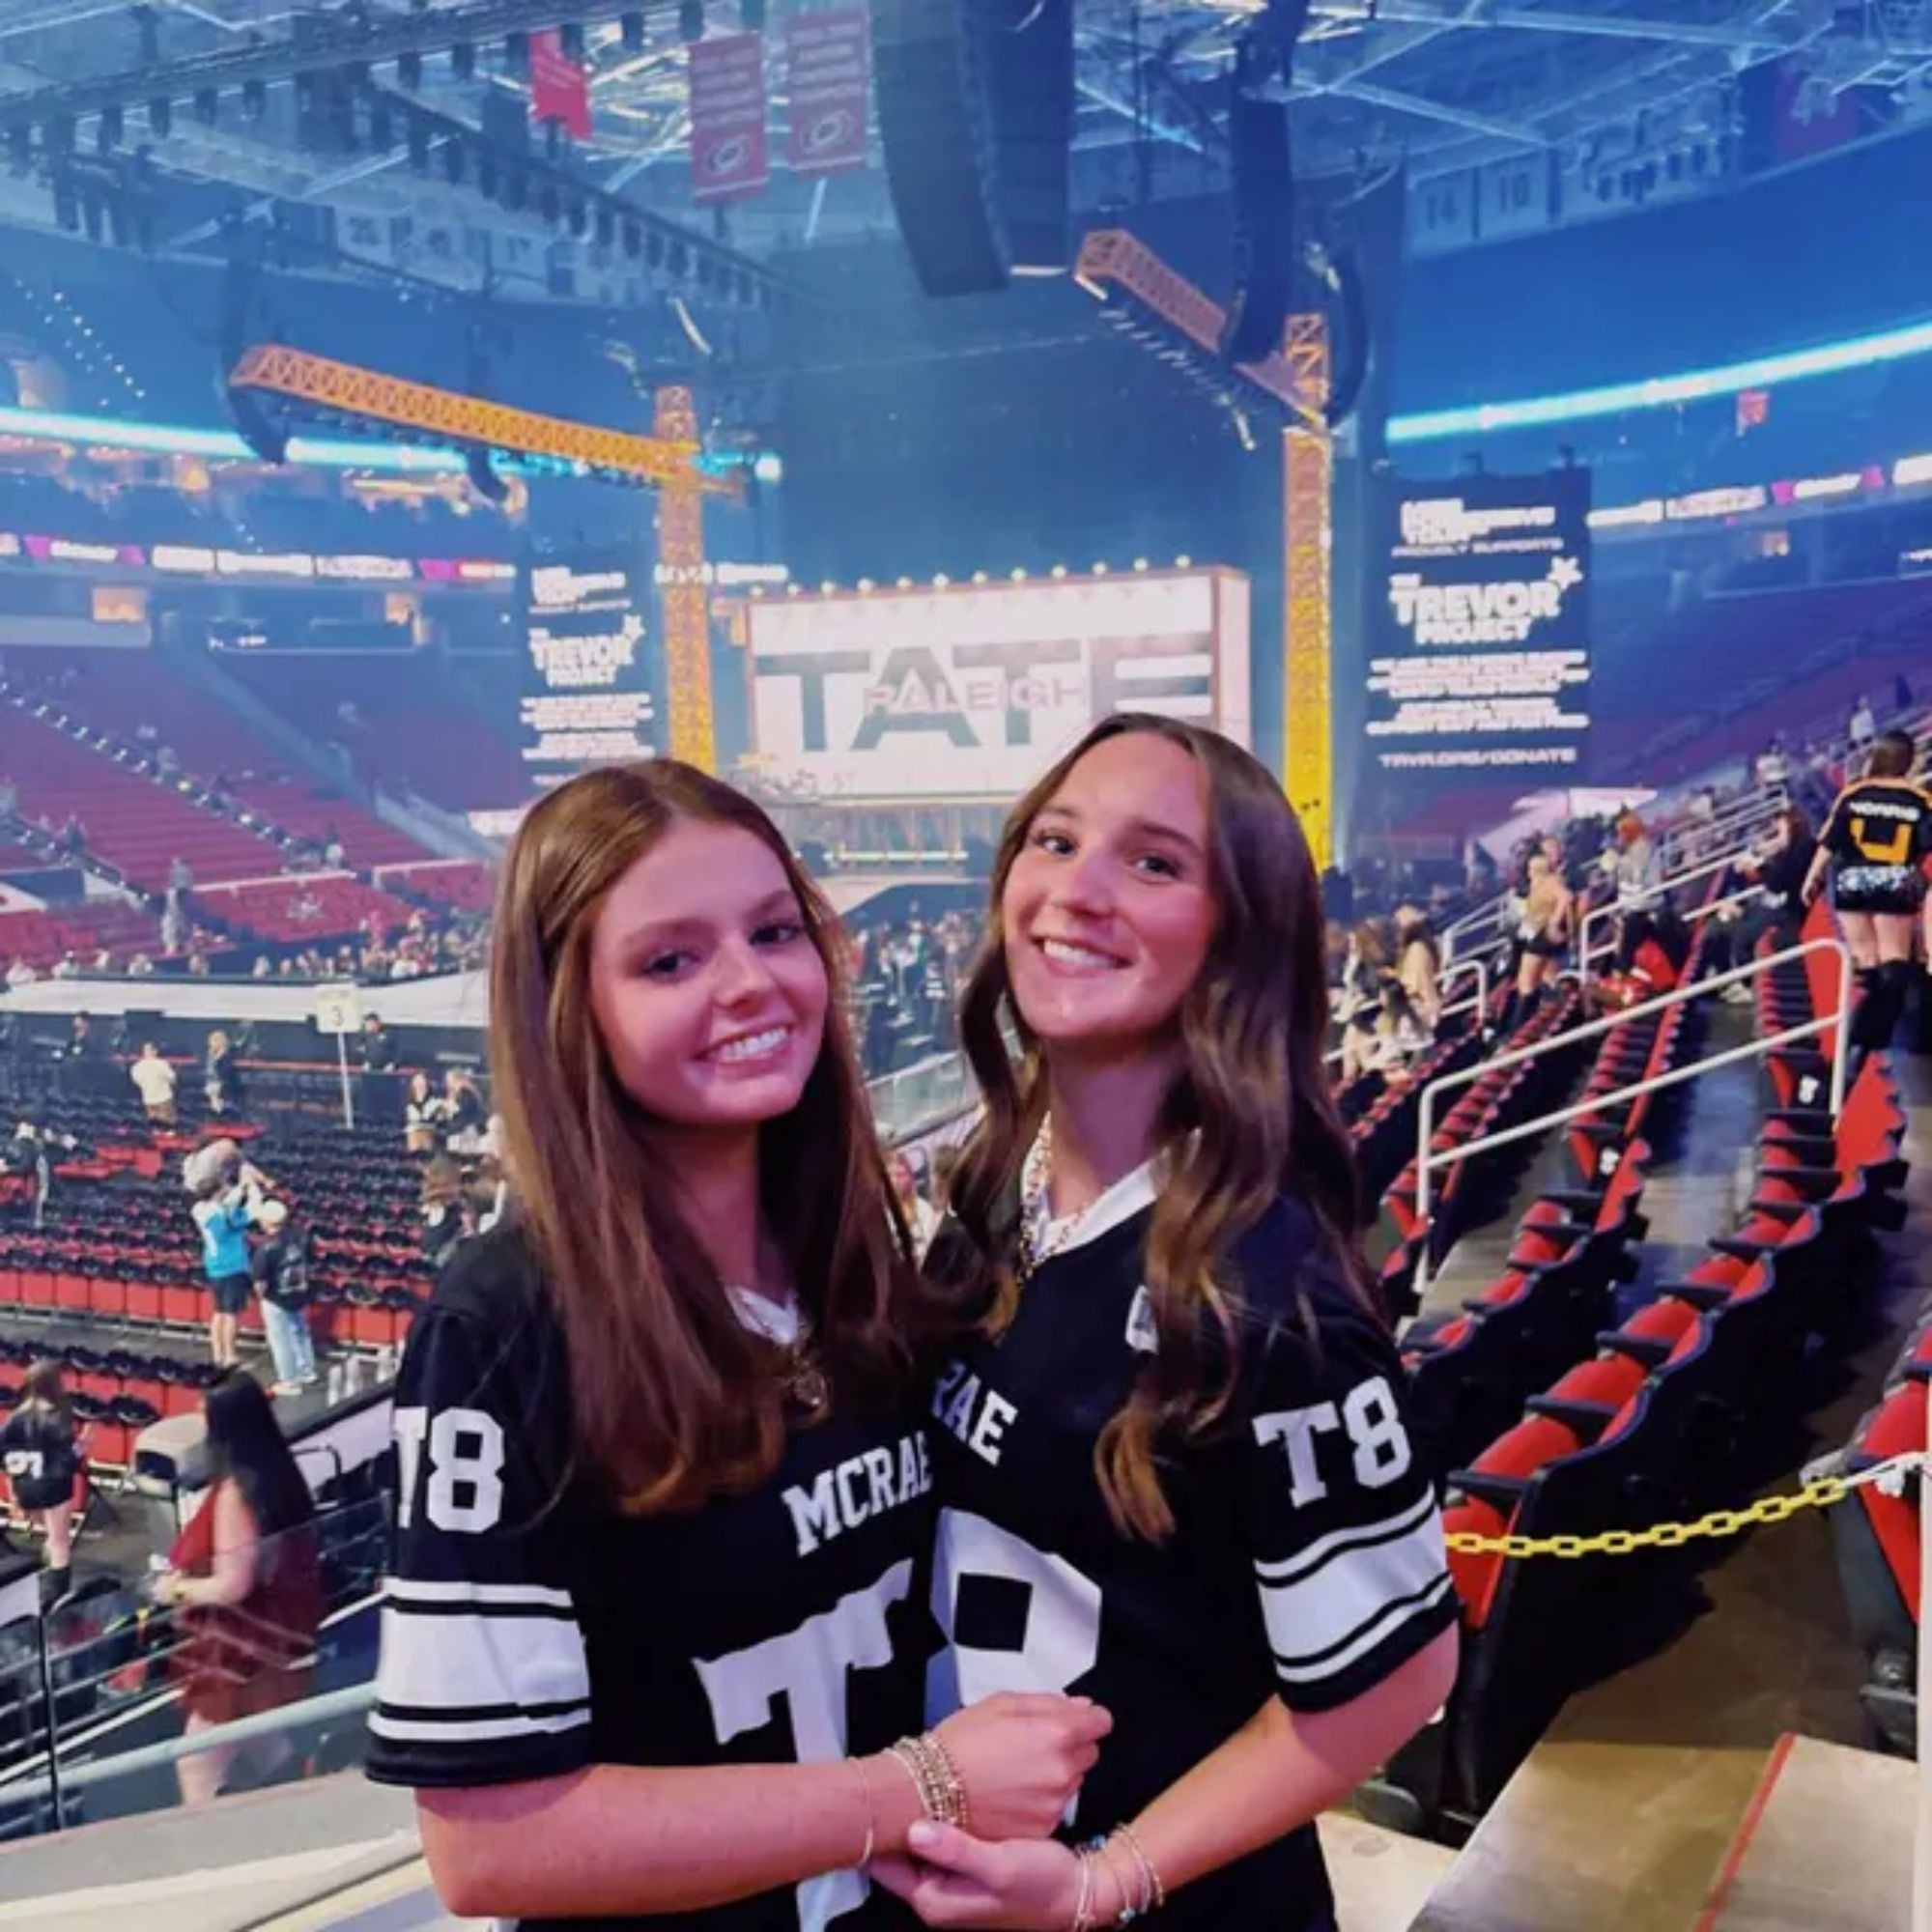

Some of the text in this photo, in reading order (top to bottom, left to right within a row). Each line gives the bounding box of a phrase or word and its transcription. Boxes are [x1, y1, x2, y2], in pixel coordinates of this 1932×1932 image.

[1388, 582, 1562, 624] TREVOR
[756, 632, 1211, 753] TATE
[861, 673, 1086, 713] RALEIGH
[1254, 1376, 1412, 1508] T8
